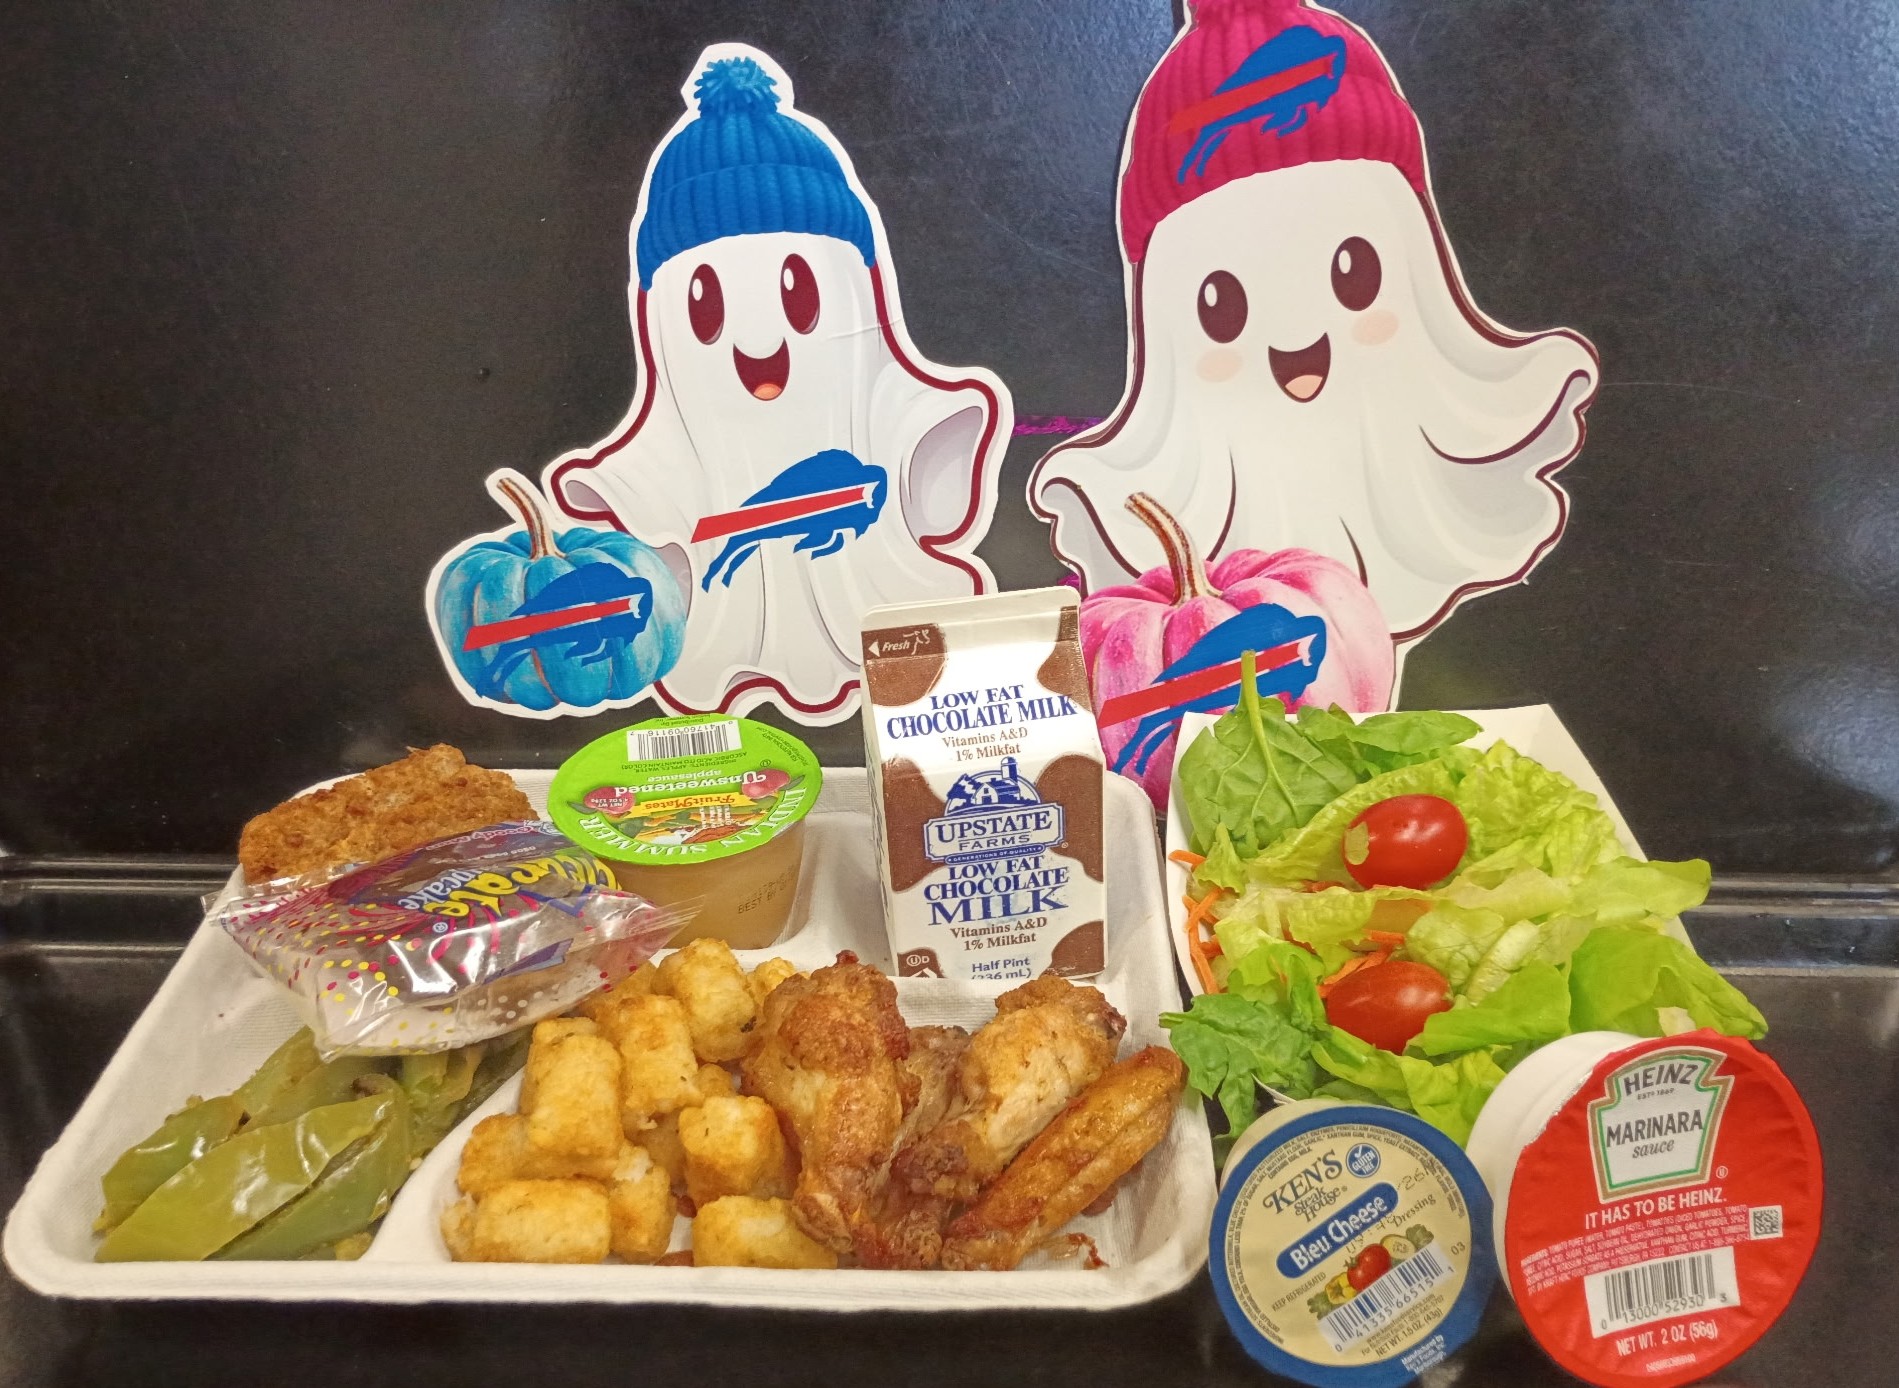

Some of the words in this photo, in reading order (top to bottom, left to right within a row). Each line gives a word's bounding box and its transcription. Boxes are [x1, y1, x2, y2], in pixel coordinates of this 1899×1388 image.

[882, 641, 910, 652] Fresh
[930, 690, 979, 710] LOW
[986, 684, 1024, 703] FAT
[887, 703, 1012, 739] CHOCOLATE
[1016, 694, 1078, 722] MILK
[942, 732, 996, 748] Vitamins
[1000, 726, 1028, 740] A&D
[956, 748, 974, 762] 1%
[976, 743, 1022, 760] Milkfat
[614, 770, 767, 798] Unsweetened
[647, 769, 722, 782] applesauce
[720, 788, 808, 848] INDIAN
[935, 810, 1052, 843] UPSTATE
[580, 816, 707, 856] SUMMER
[959, 834, 1031, 852] FARMS
[924, 866, 1070, 902] CHOCOLATE
[949, 862, 999, 881] LOW
[1006, 854, 1044, 874] FAT
[926, 884, 1070, 926] MILK
[950, 923, 1010, 939] Vitamins
[1014, 916, 1048, 931] A&D
[964, 939, 984, 951] 1%
[987, 932, 1037, 949] Milkfat
[972, 961, 1000, 973] Half
[1003, 957, 1031, 970] Pint
[1624, 1064, 1698, 1096] HEINZ
[1606, 1110, 1704, 1148] MARINARA
[1352, 1150, 1376, 1172] GLUTEN
[1632, 1140, 1674, 1158] sauce
[1262, 1148, 1342, 1214] KEN'S
[1294, 1186, 1326, 1216] Steak
[1302, 1187, 1341, 1222] House
[1392, 1194, 1436, 1227] Dressing
[1586, 1212, 1598, 1230] IT
[1602, 1204, 1630, 1226] HAS
[1634, 1199, 1654, 1216] TO
[1658, 1194, 1676, 1212] BE
[1679, 1187, 1728, 1209] HEINZ.
[1290, 1236, 1331, 1270] Bleu
[1328, 1197, 1388, 1242] Cheese
[1450, 1242, 1466, 1255] 03
[1272, 1298, 1286, 1312] KEEP
[1286, 1272, 1326, 1303] REFRIGERATED
[1356, 1306, 1393, 1338] 41335
[1396, 1278, 1434, 1308] 66515
[1601, 1320, 1608, 1330] 0
[1622, 1302, 1659, 1324] 13000
[1664, 1294, 1704, 1314] 52930
[1375, 1344, 1390, 1357] NET
[1388, 1334, 1404, 1348] WT.
[1424, 1308, 1444, 1324] (43g)
[1616, 1336, 1636, 1357] NET
[1638, 1330, 1658, 1350] WT.
[1660, 1328, 1669, 1345] 2
[1670, 1324, 1688, 1342] OZ
[1689, 1319, 1719, 1344] (56g)
